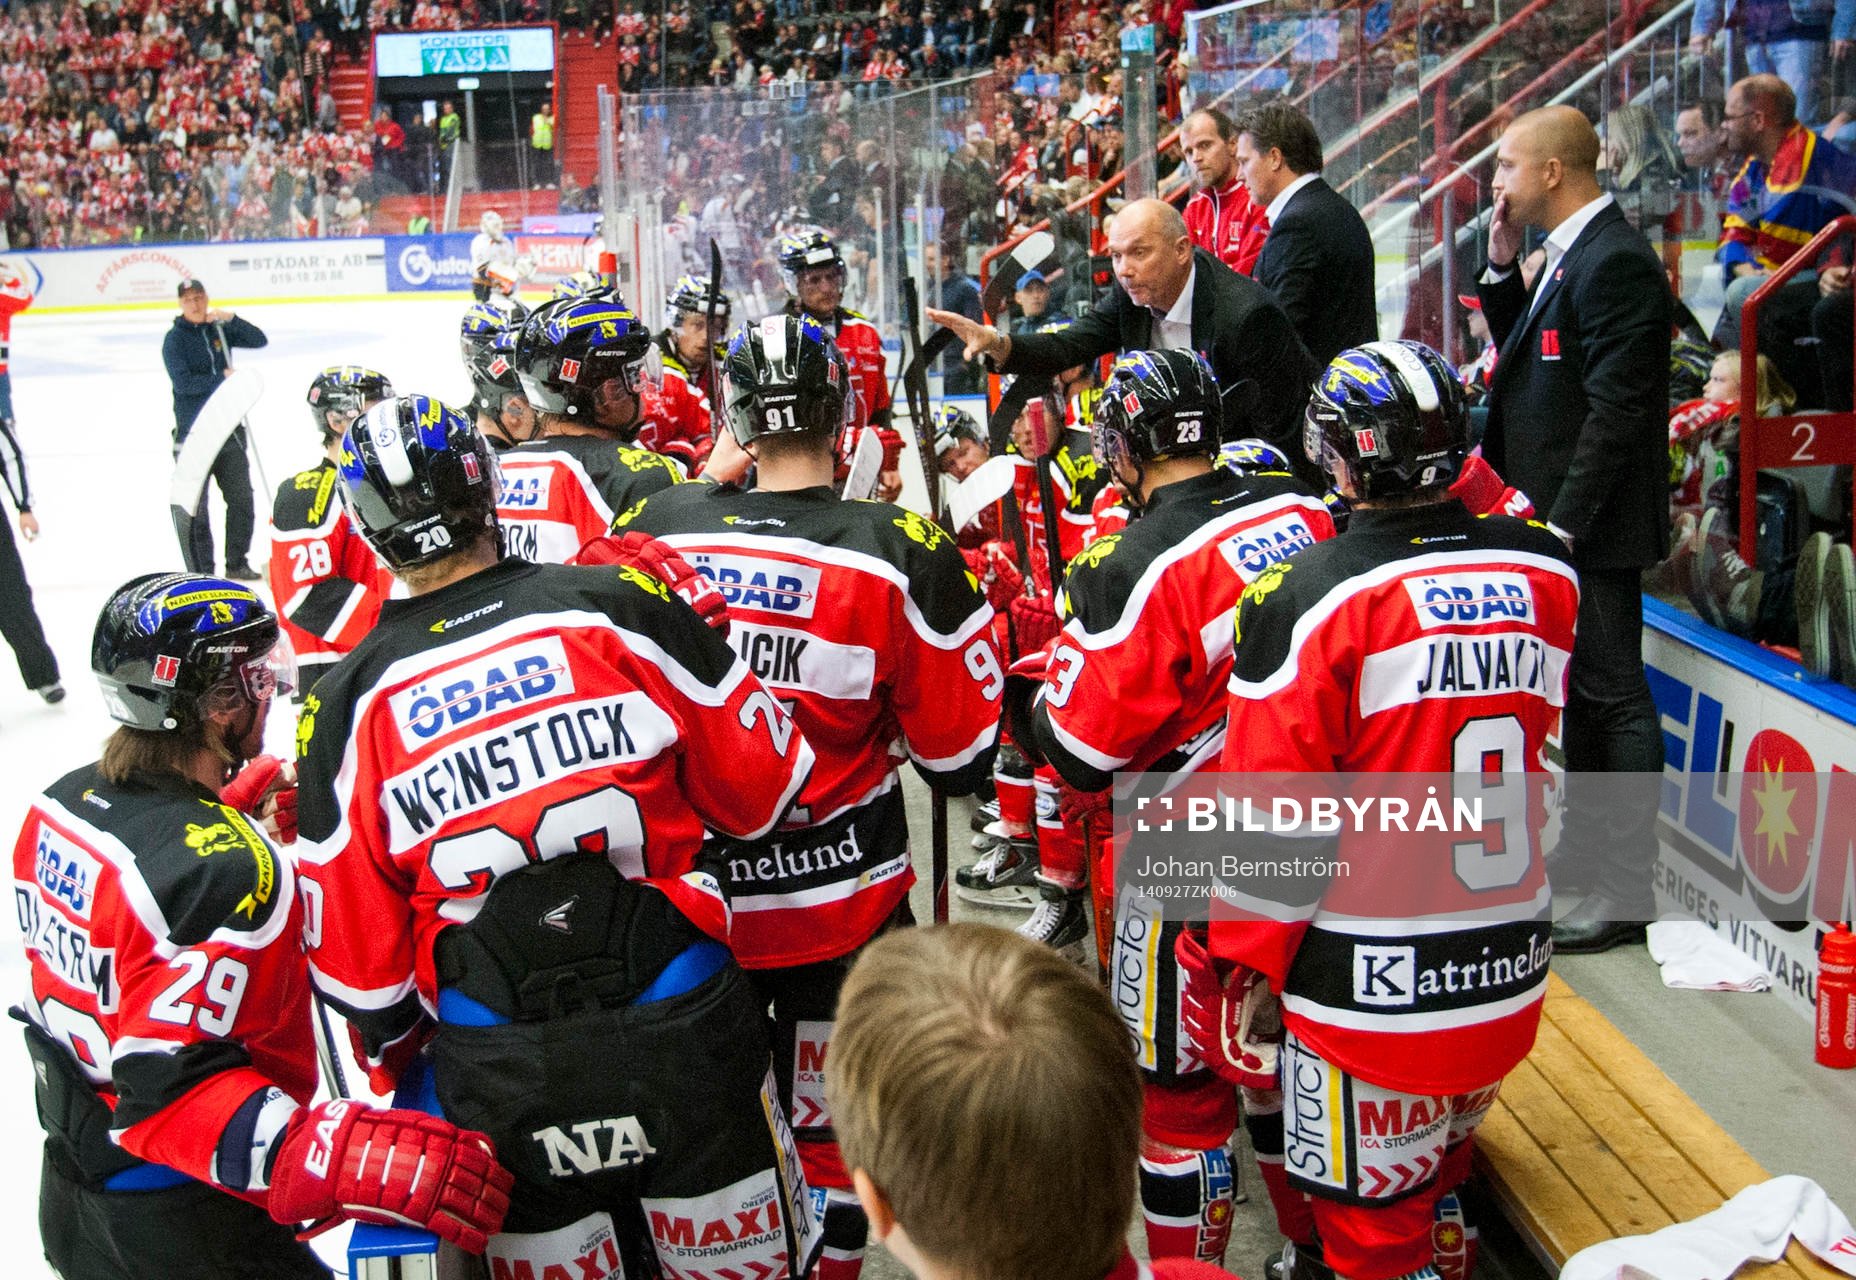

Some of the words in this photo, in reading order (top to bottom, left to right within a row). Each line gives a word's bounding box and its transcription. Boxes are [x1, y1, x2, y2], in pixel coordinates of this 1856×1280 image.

[420, 35, 510, 48] KONDITORI
[427, 47, 510, 73] VASA
[341, 253, 363, 267] AB
[595, 350, 627, 358] EASTON
[764, 394, 797, 403] EASTON
[765, 405, 796, 431] 91
[1176, 420, 1200, 444] 23
[1416, 450, 1448, 461] EASTON
[1791, 422, 1816, 461] 2
[1420, 466, 1437, 486] 9
[404, 514, 441, 533] EASTON
[414, 525, 452, 554] 20
[1232, 523, 1313, 573] ÖBAB
[1423, 534, 1467, 543] EASTON
[289, 539, 333, 582] 28
[1424, 578, 1527, 621] ÖBAB
[444, 600, 503, 629] EASTON
[207, 645, 249, 654] EASTON
[964, 638, 1004, 702] 9
[1045, 644, 1085, 708] 3
[408, 655, 557, 739] ÖBAB
[737, 689, 794, 758] 2
[391, 703, 637, 836] WEINSTOCK
[1450, 712, 1534, 893] 9
[729, 824, 863, 882] nelund
[36, 831, 87, 911] ÖBAB
[869, 860, 905, 882] EASTON
[1655, 862, 1719, 930] ERIGES
[148, 949, 250, 1038] 29
[797, 1072, 816, 1083] ICA
[1287, 1036, 1327, 1178] Struct
[532, 1115, 656, 1177] NA
[1360, 1138, 1381, 1149] ICA
[741, 1191, 775, 1210] ÖREBRO
[650, 1199, 781, 1248] MAXI
[579, 1230, 611, 1255] ÖREBRO
[676, 1229, 782, 1258] STORMARKNAD
[492, 1238, 620, 1280] MAXI
